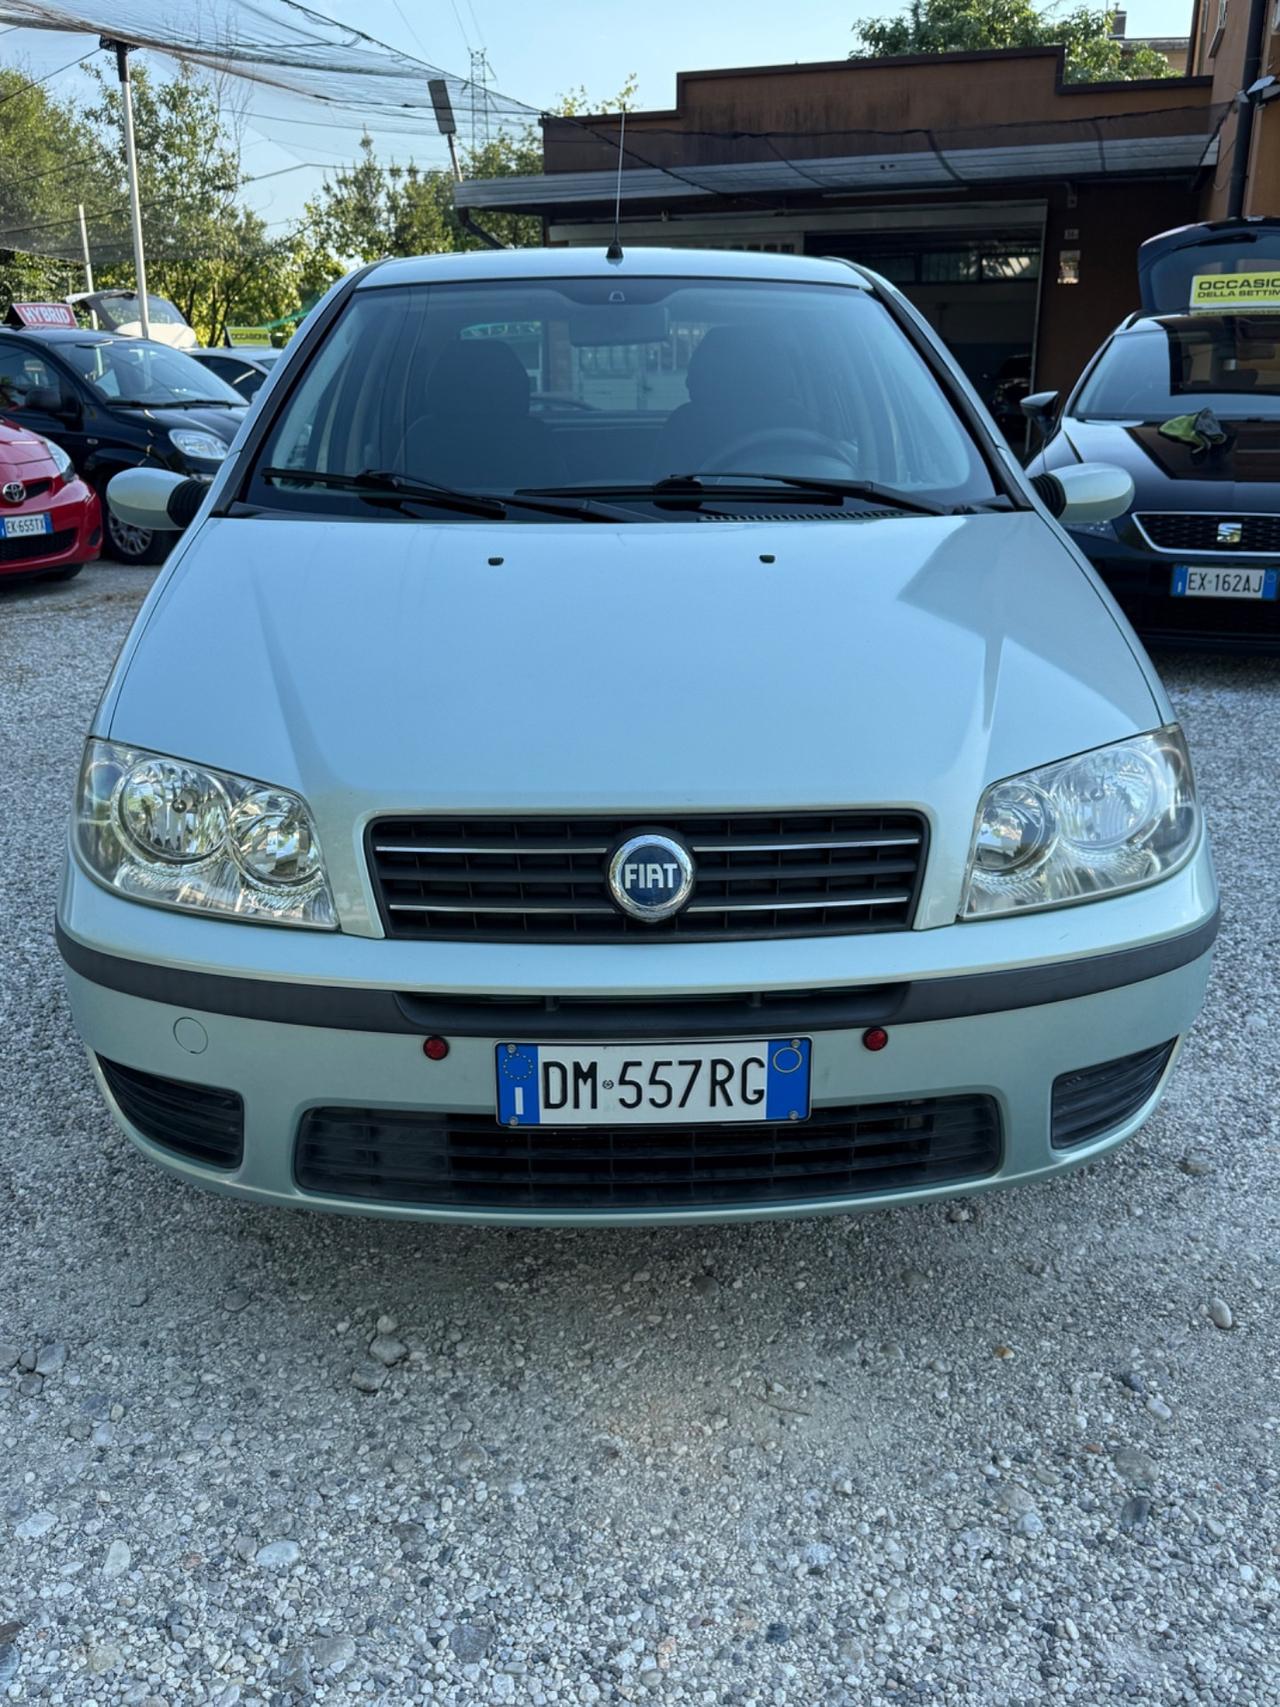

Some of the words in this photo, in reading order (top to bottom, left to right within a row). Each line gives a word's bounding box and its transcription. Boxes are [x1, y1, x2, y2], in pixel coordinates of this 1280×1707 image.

[1197, 290, 1236, 299] DELLA
[20, 306, 71, 323] HYBRID
[624, 863, 678, 889] FIAT
